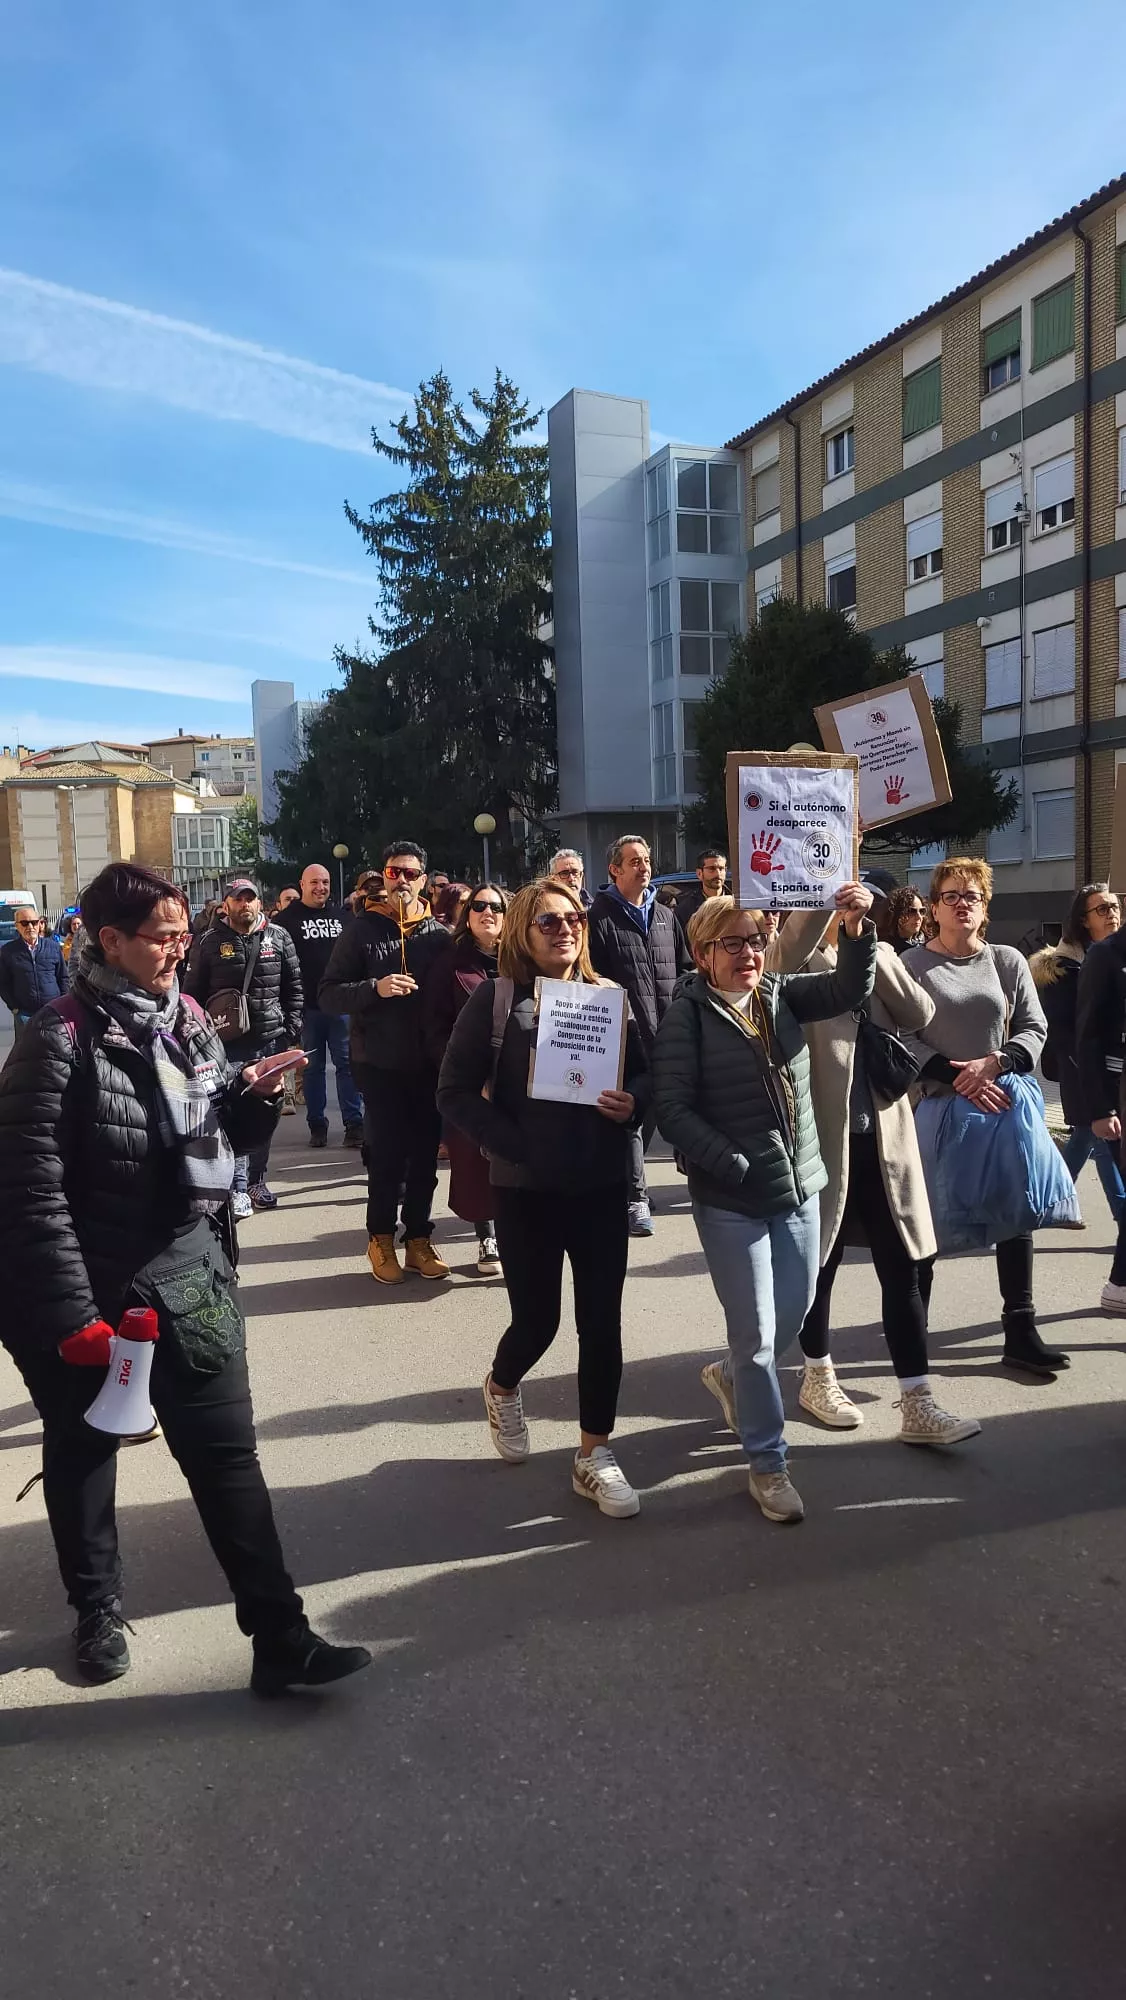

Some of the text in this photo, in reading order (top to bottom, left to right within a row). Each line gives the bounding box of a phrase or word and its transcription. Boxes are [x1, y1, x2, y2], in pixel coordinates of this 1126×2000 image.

[869, 746, 894, 758] Queremos
[883, 751, 905, 761] Derechos
[906, 746, 919, 754] para
[870, 758, 907, 772] Poder Avanzar
[769, 800, 778, 811] Si
[782, 801, 791, 811] el
[794, 802, 846, 812] autónomo
[766, 816, 827, 829] desaparece
[813, 843, 830, 858] 30
[818, 858, 825, 868] N
[771, 882, 823, 894] España se
[770, 898, 825, 908] desvanece
[301, 918, 342, 930] JACK&
[556, 1000, 573, 1009] Apoyo
[581, 1004, 600, 1012] sector
[602, 1006, 609, 1014] de
[550, 1010, 582, 1020] peluquería
[588, 1015, 612, 1024] estética
[600, 1026, 606, 1034] el
[558, 1031, 585, 1040] Congreso
[587, 1034, 594, 1042] de
[550, 1040, 585, 1051] Proposición
[596, 1046, 606, 1054] Ley
[119, 1359, 132, 1387] PYLE
